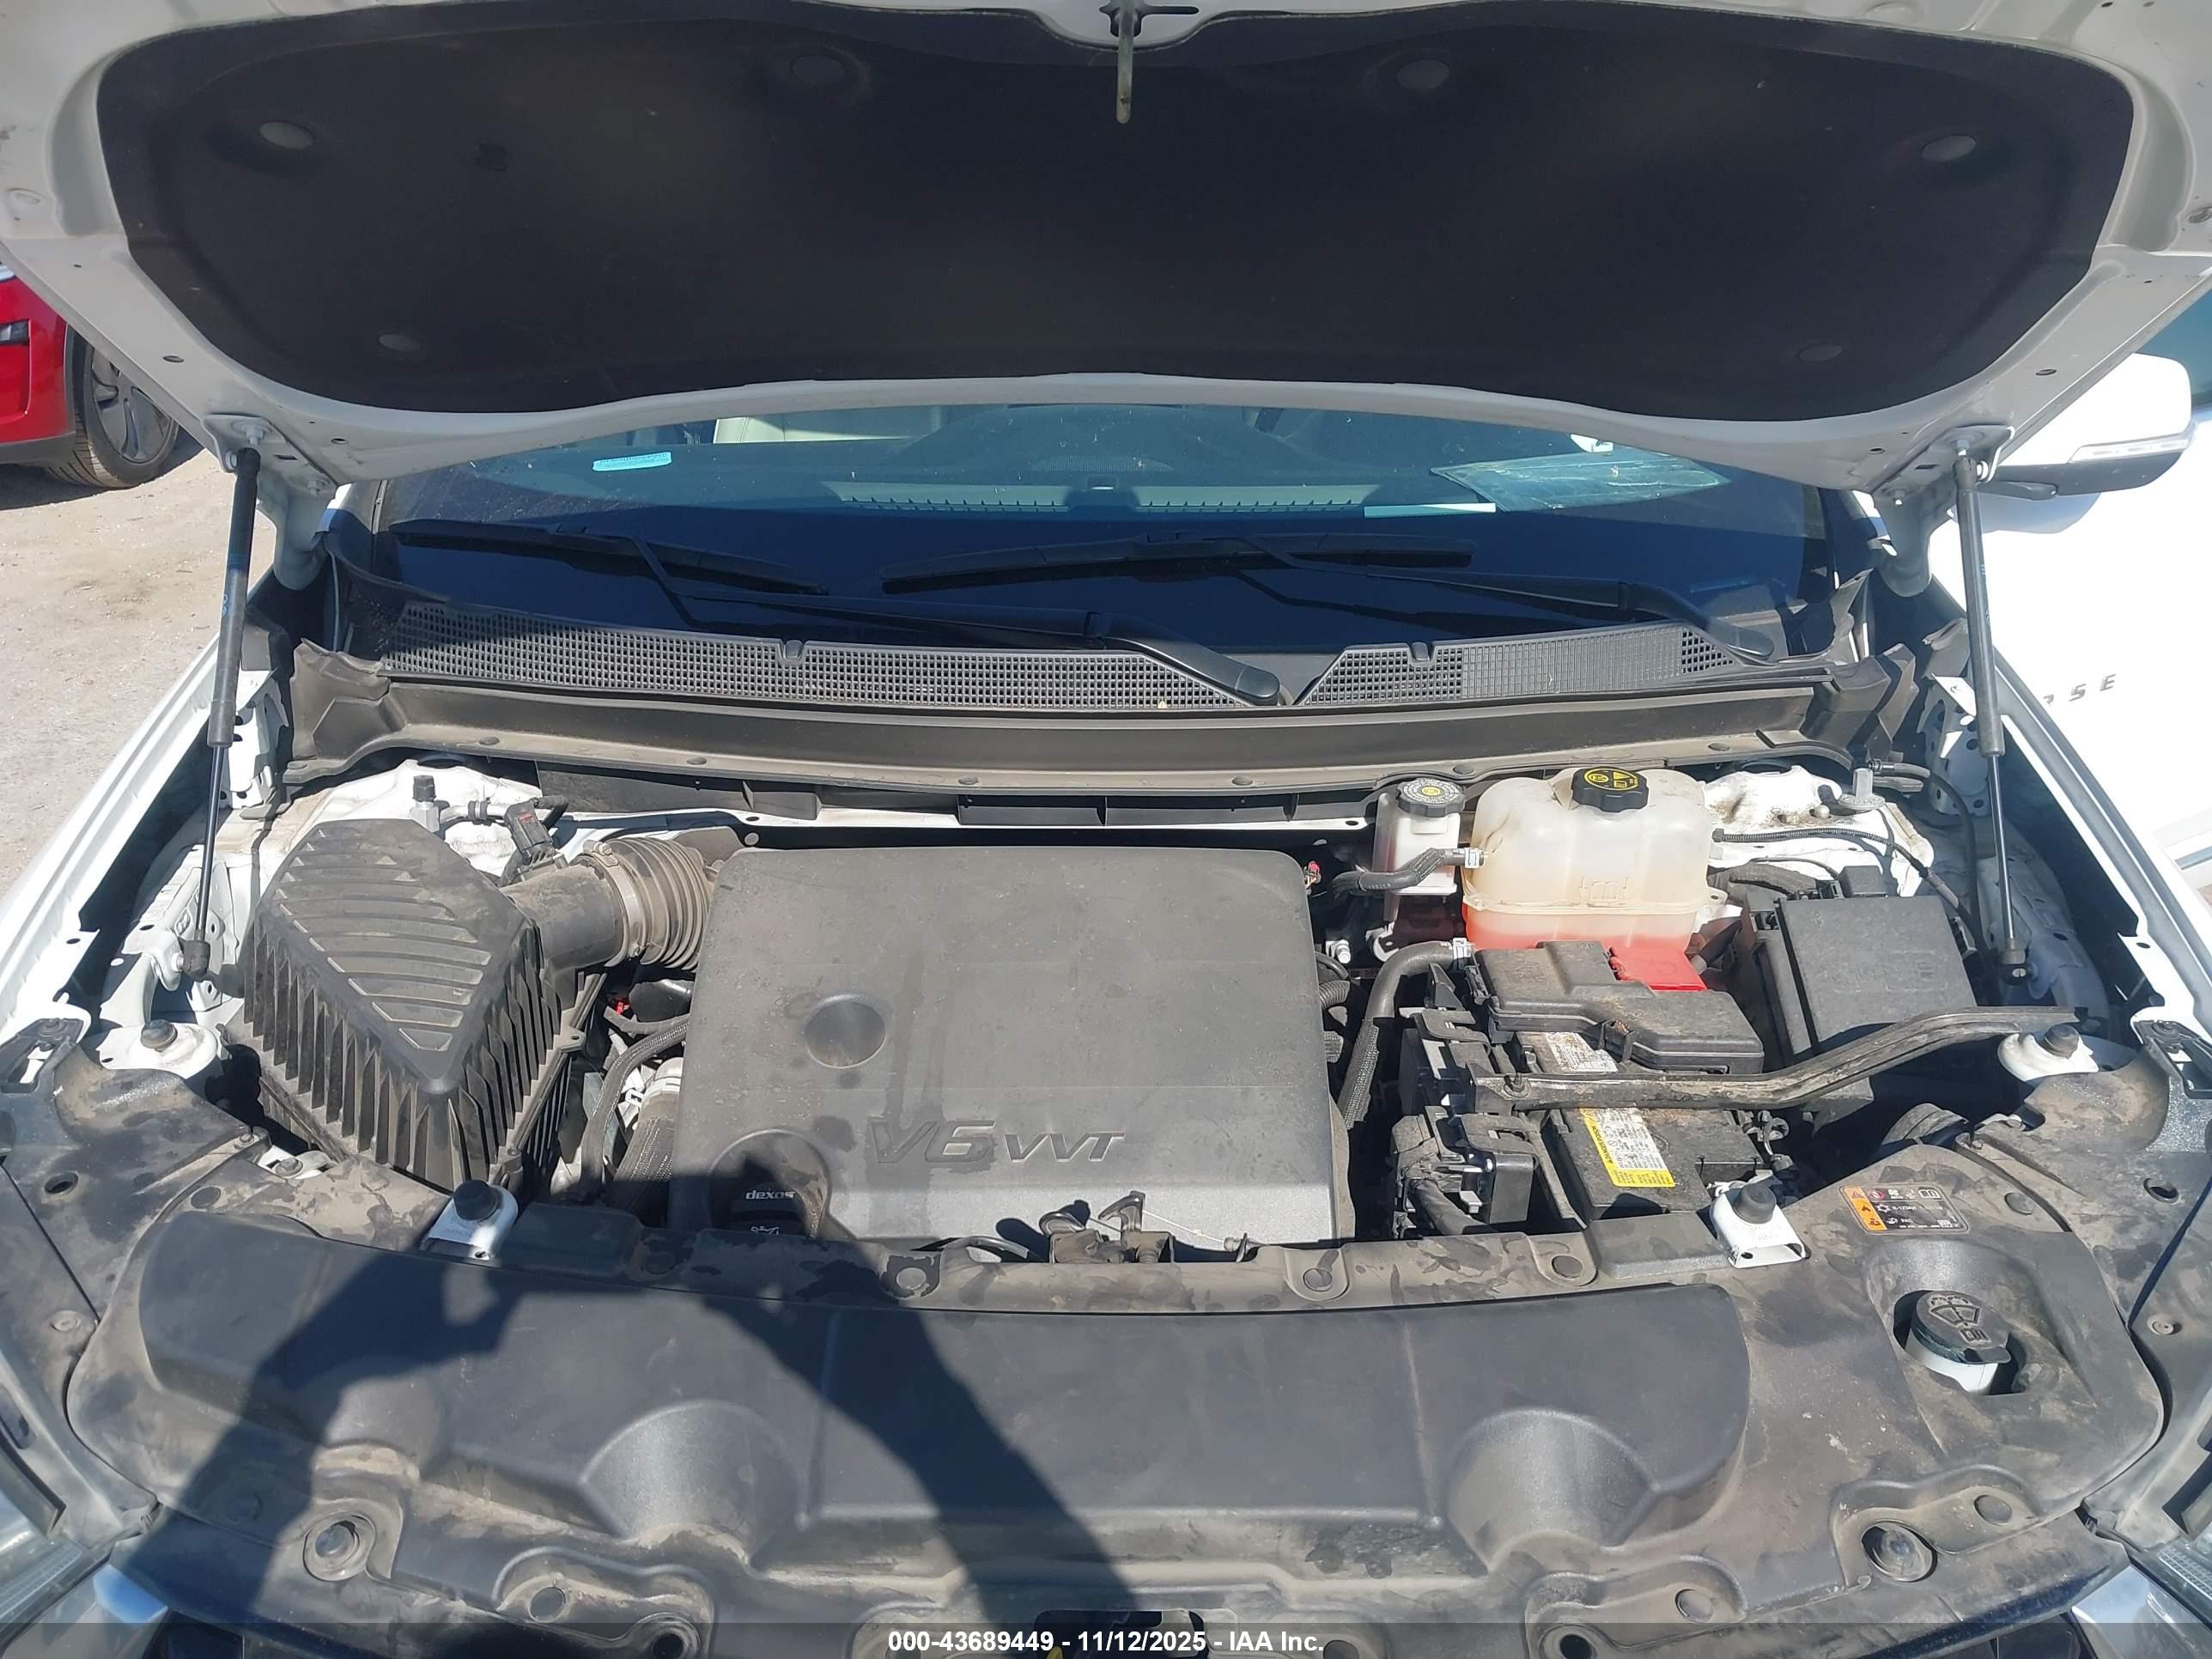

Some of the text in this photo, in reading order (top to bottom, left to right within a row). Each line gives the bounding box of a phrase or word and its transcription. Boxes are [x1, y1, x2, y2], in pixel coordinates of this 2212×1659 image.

[871, 1120, 1125, 1163] V6 VVT
[745, 1190, 795, 1200] dexos
